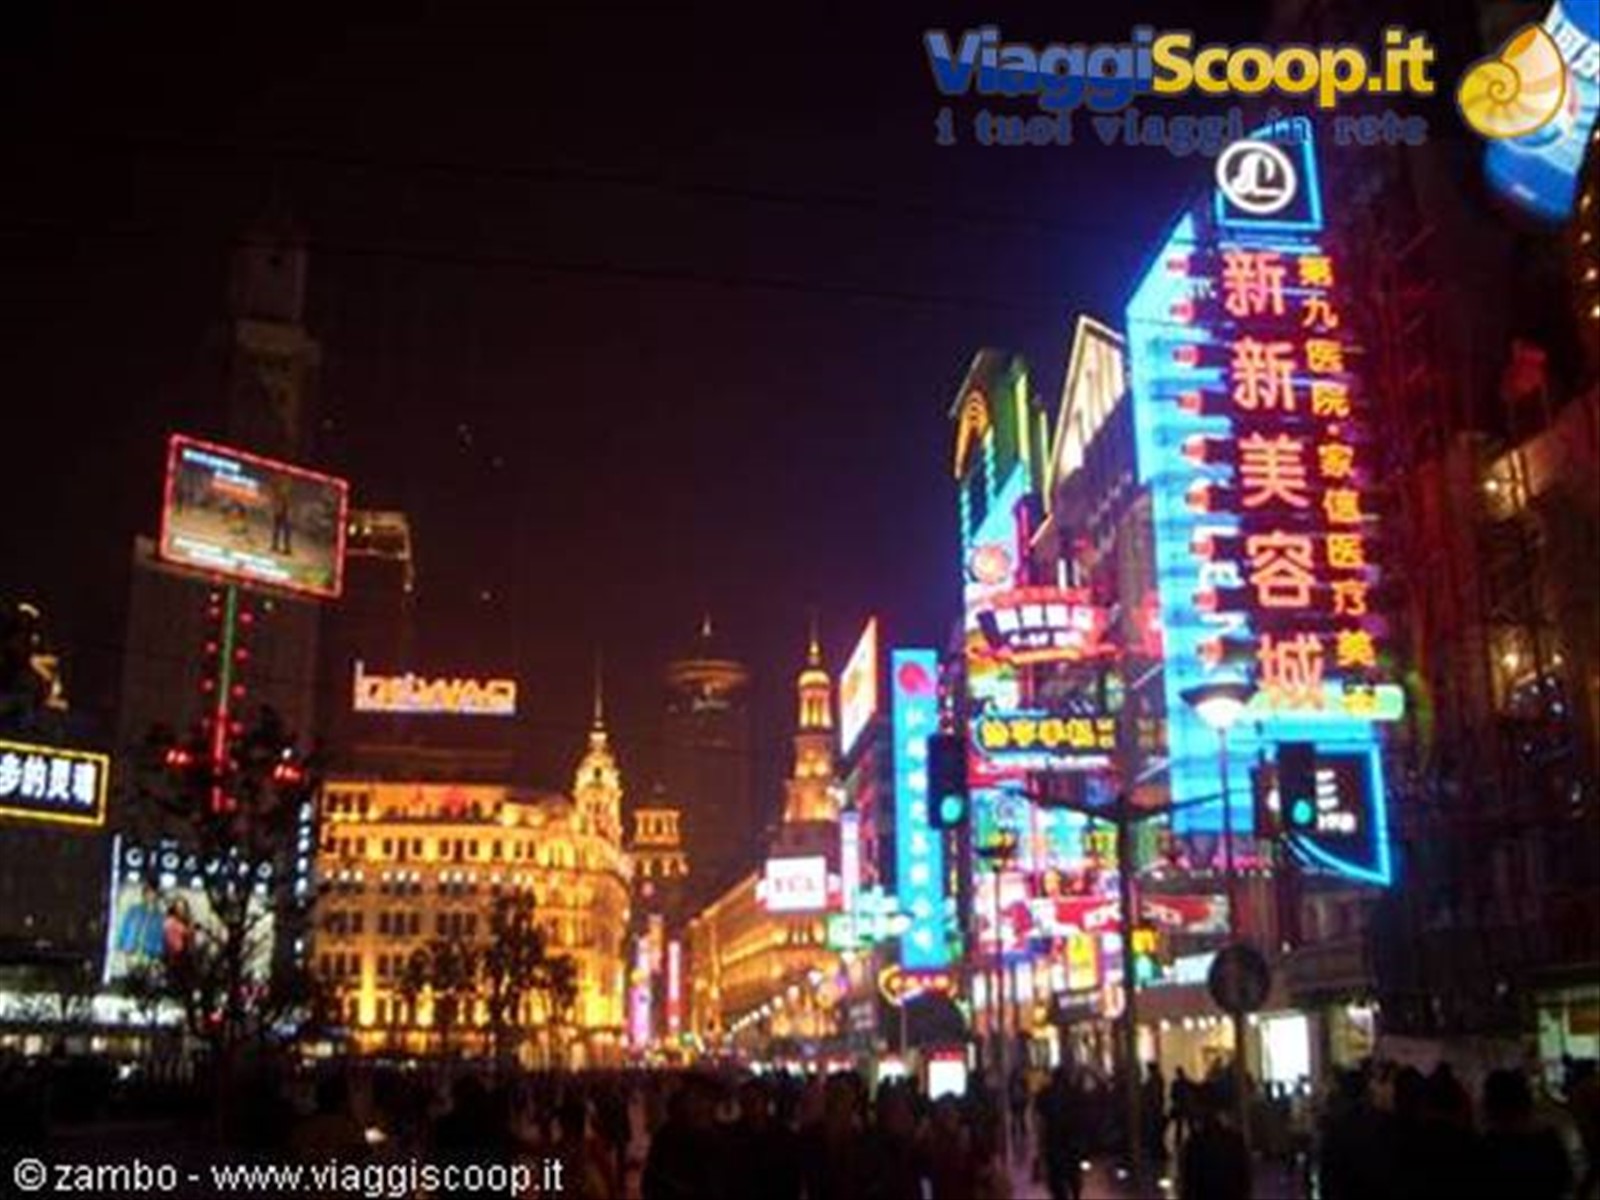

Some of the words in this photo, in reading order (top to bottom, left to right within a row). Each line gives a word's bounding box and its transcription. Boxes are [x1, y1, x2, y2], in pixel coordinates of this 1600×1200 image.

[1222, 252, 1325, 709] 新新美容城
